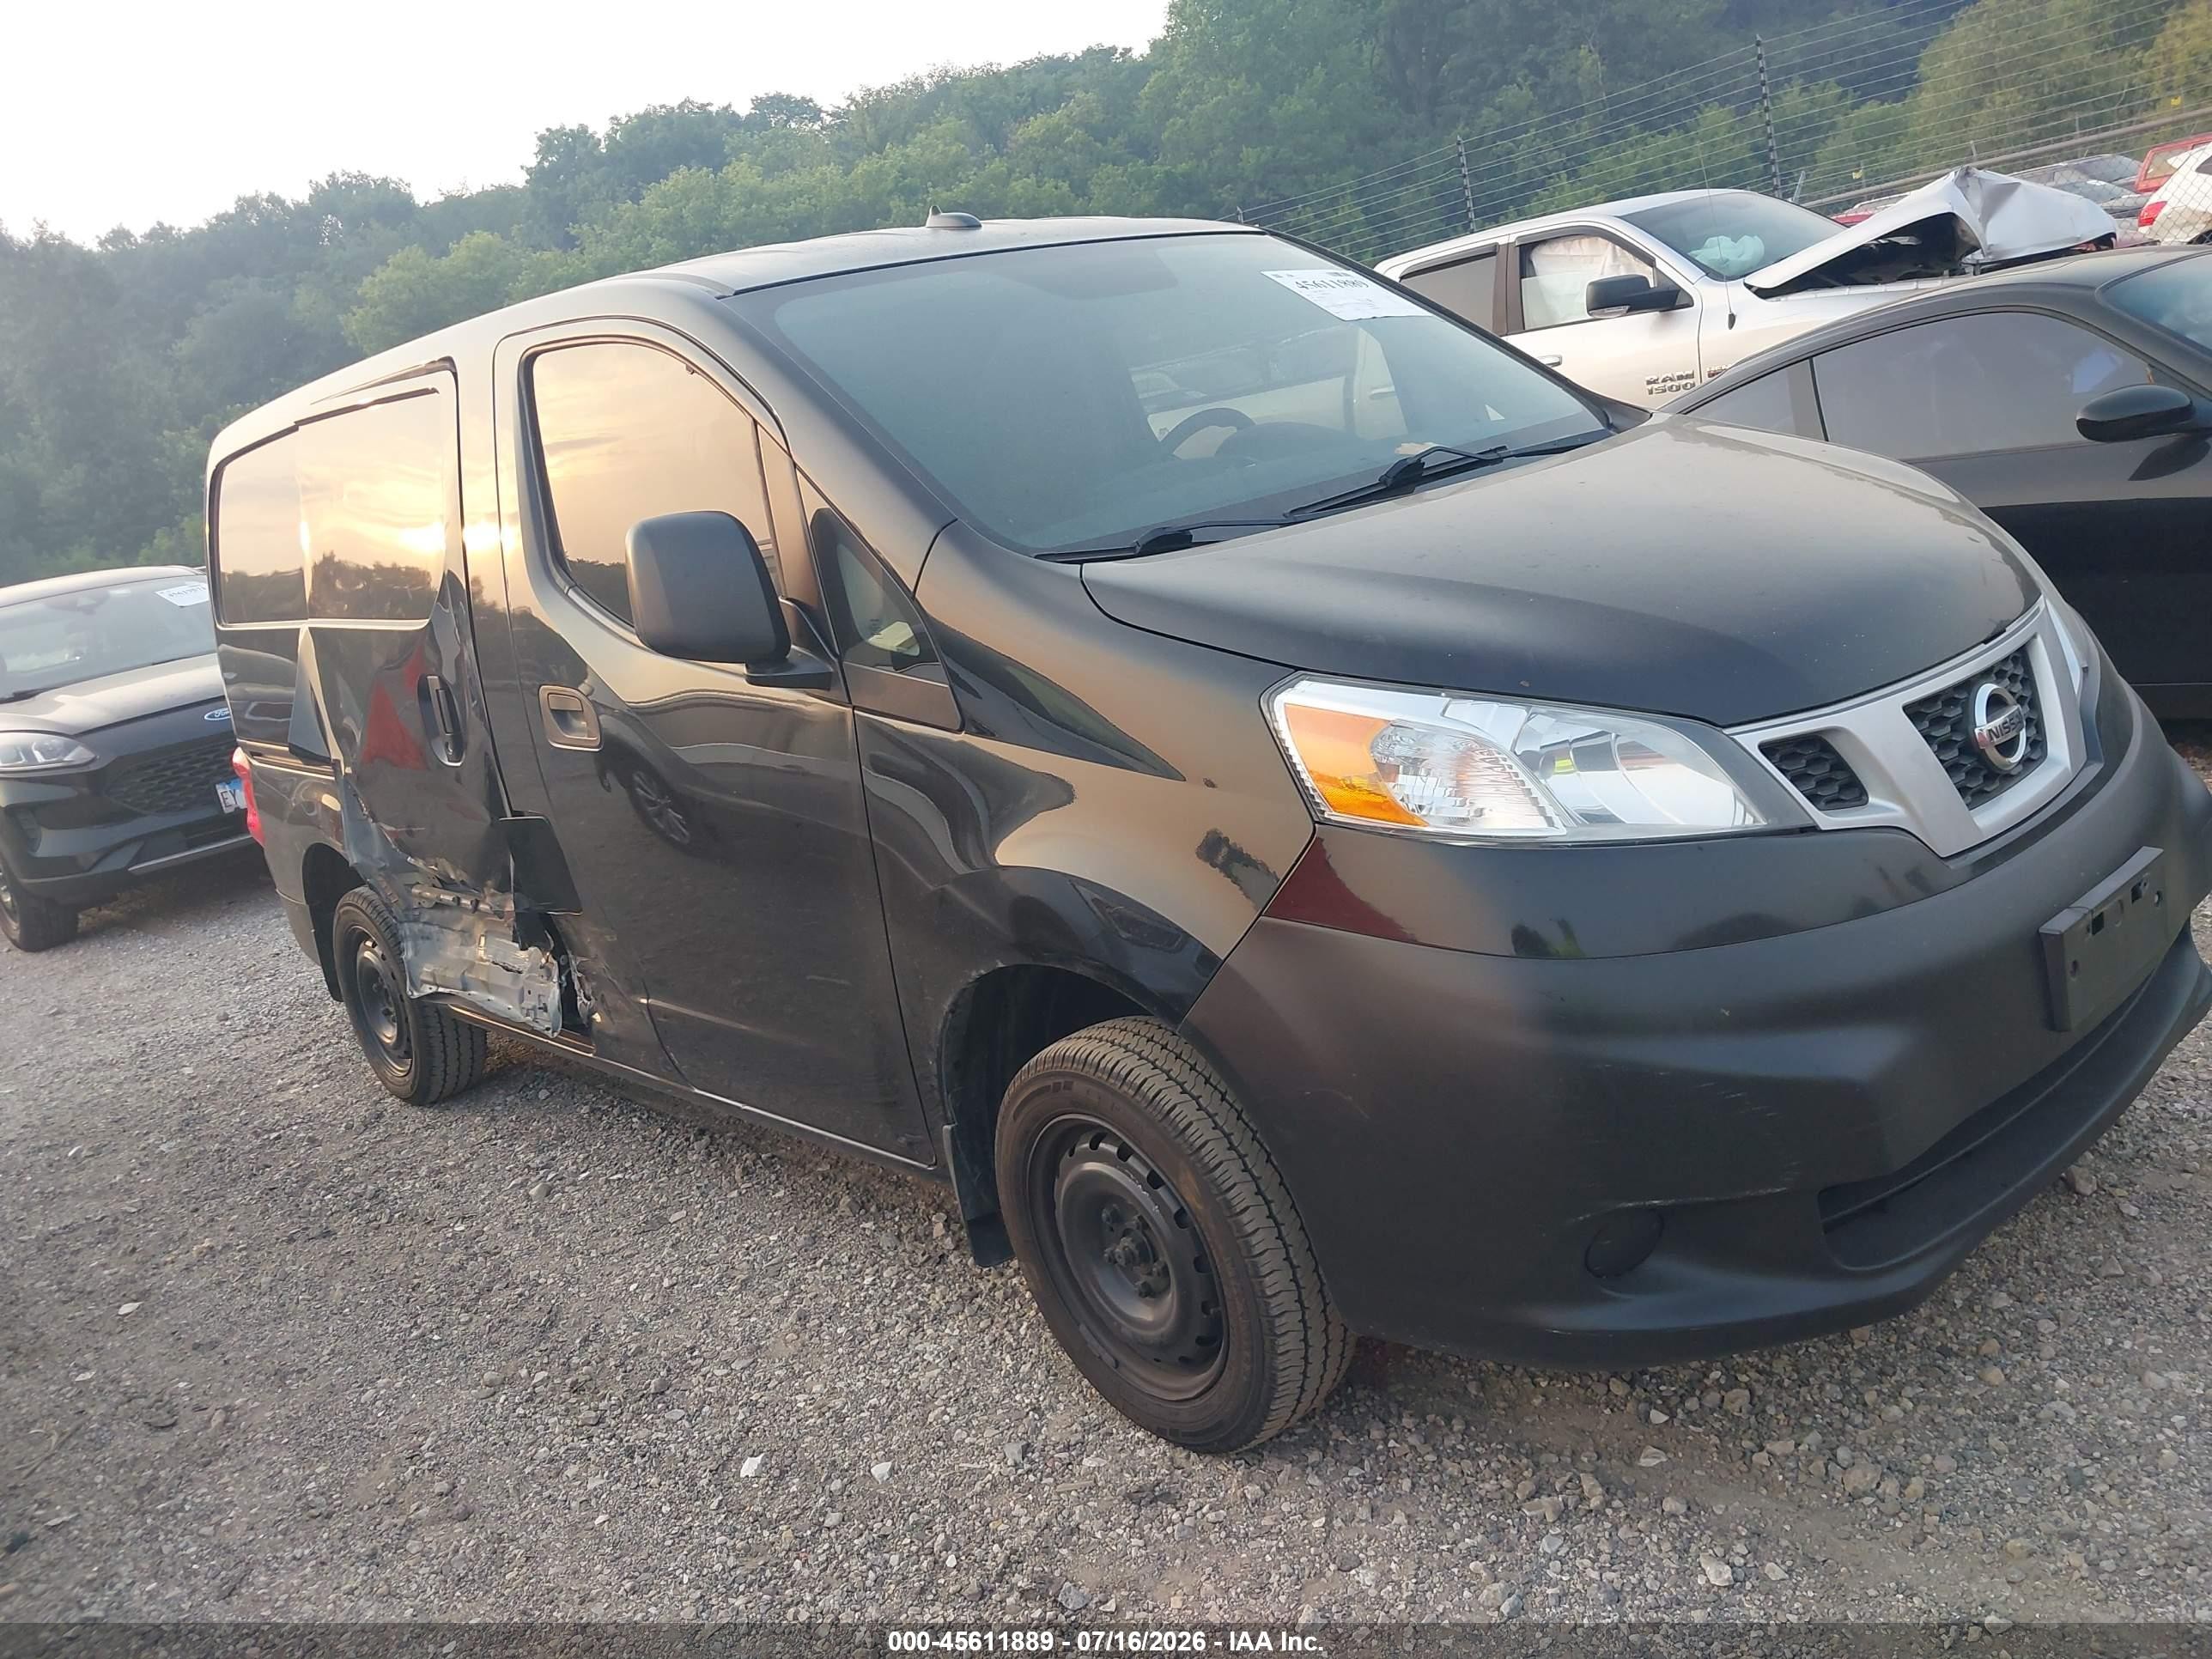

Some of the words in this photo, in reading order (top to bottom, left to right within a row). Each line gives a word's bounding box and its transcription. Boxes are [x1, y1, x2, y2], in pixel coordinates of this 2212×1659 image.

[1295, 279, 1369, 289] 45611889
[1645, 370, 1695, 386] RAM
[1647, 380, 1696, 396] 1500
